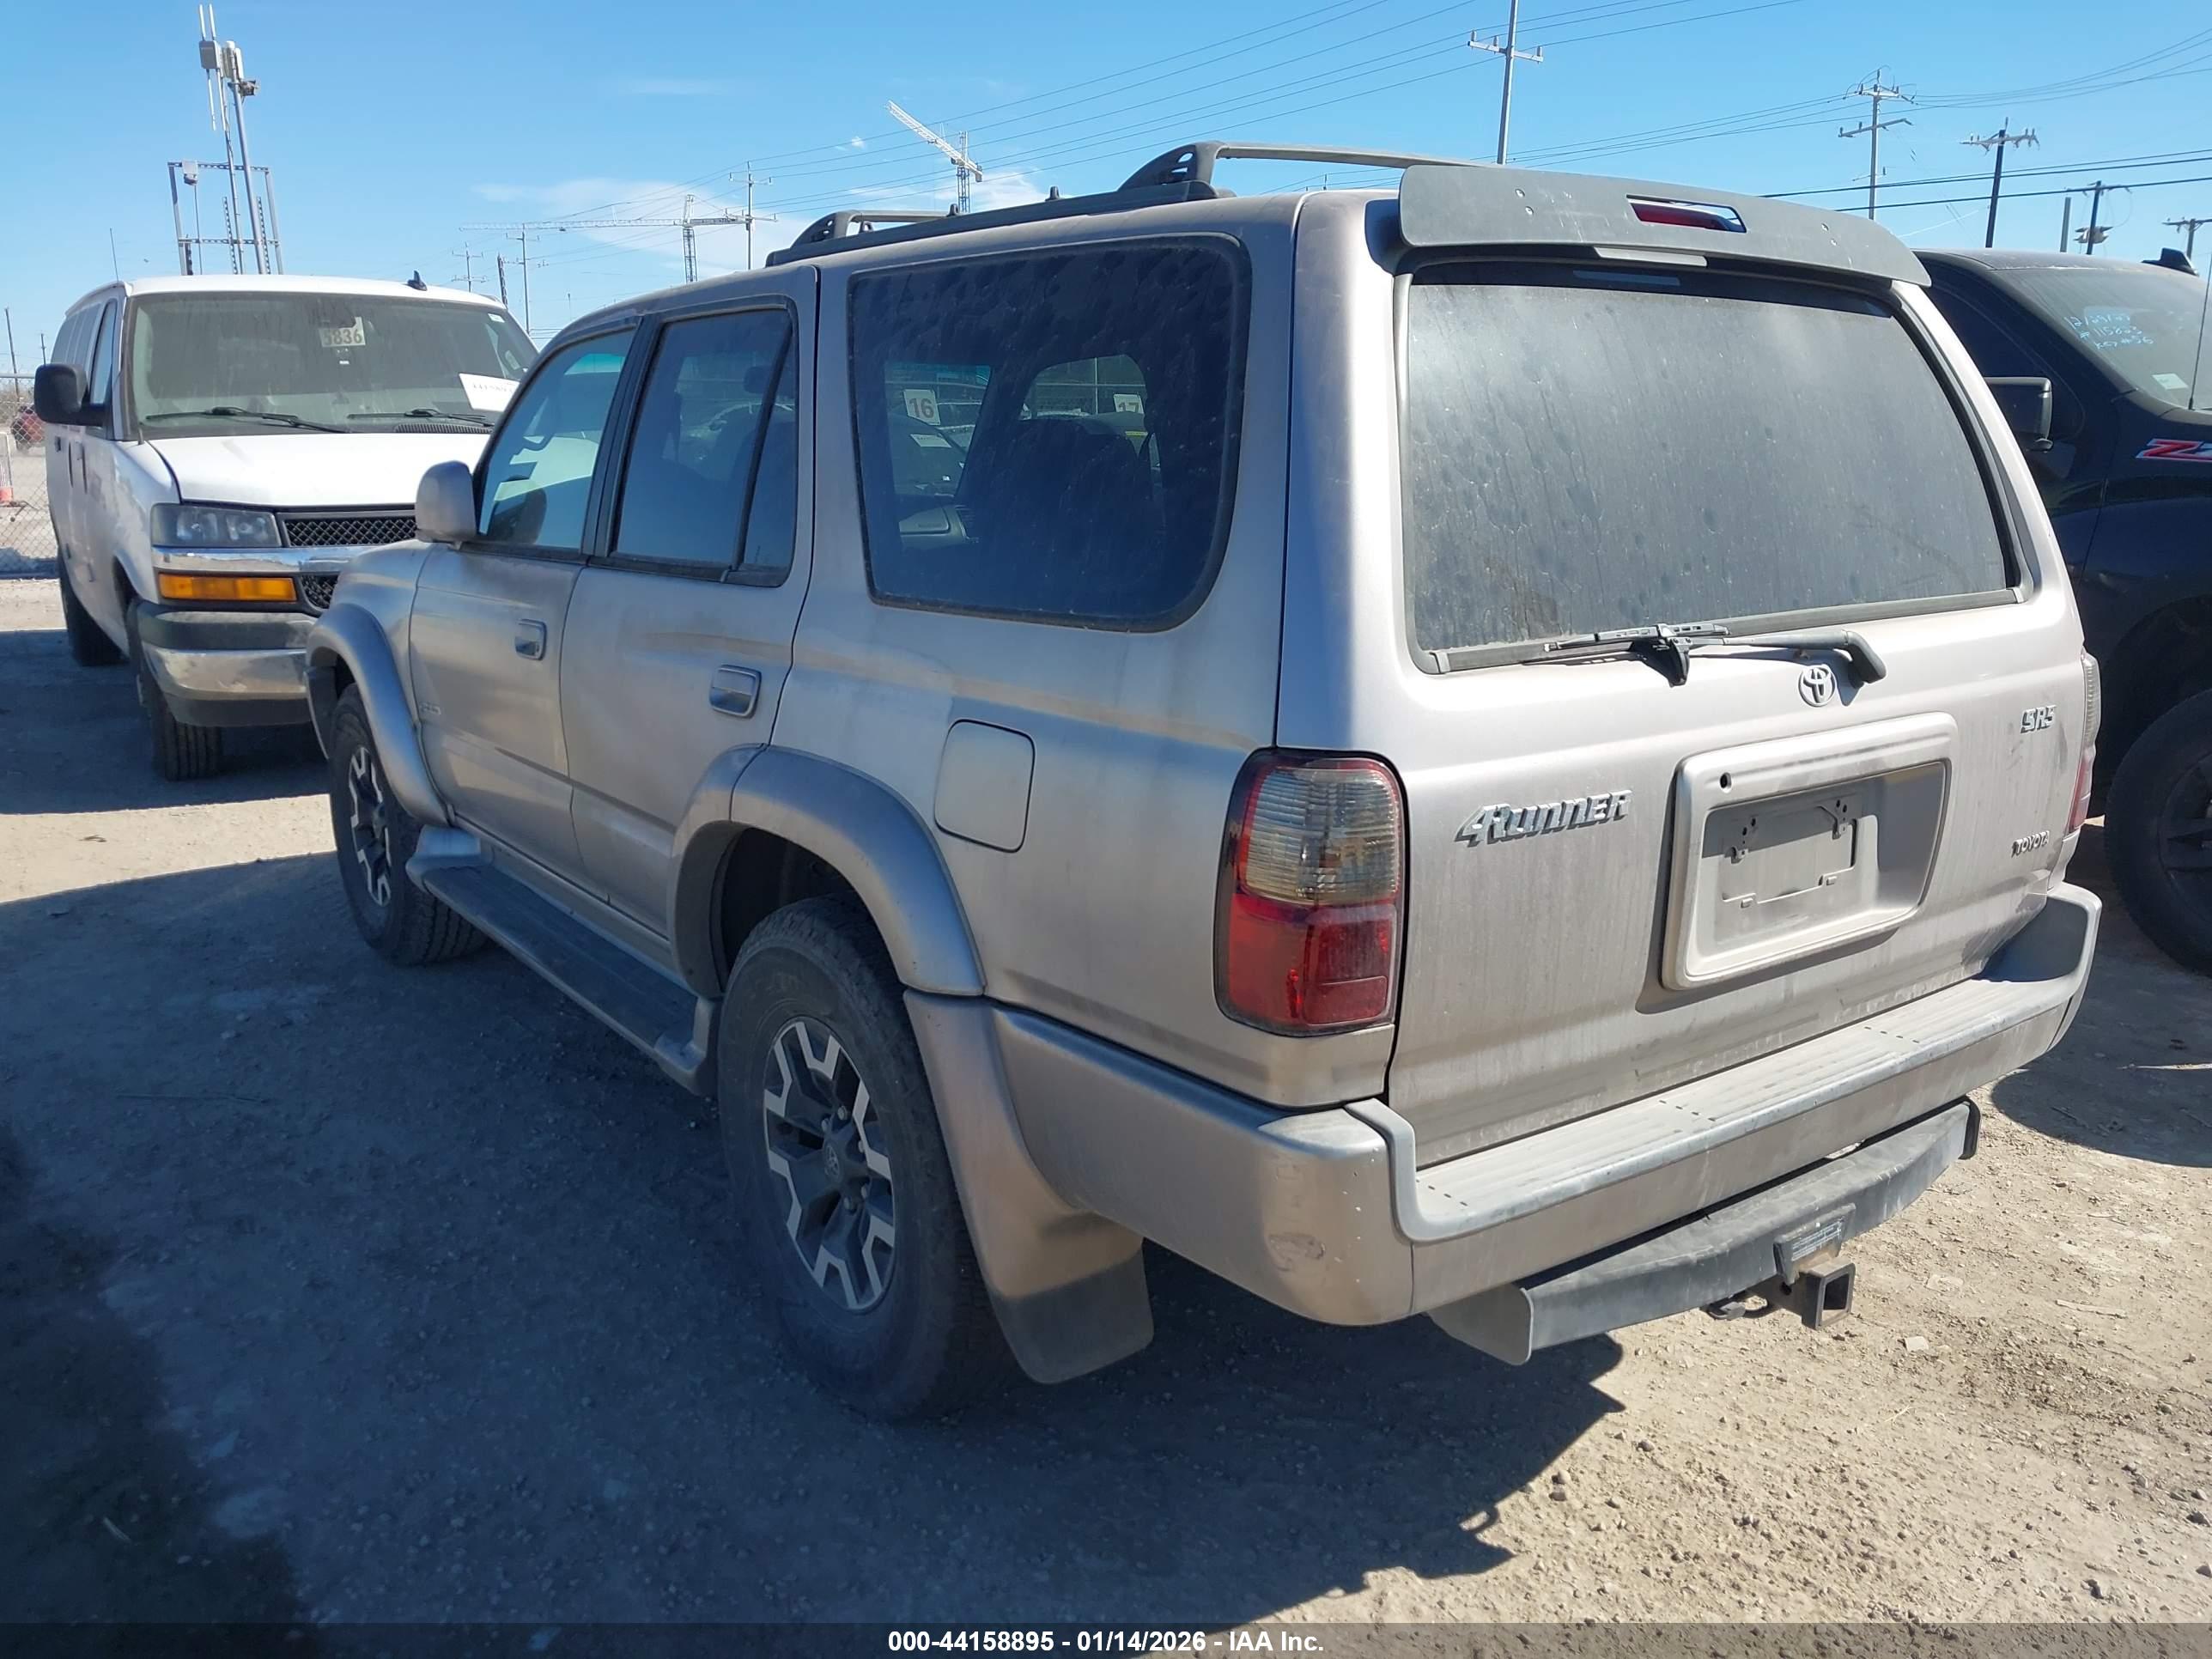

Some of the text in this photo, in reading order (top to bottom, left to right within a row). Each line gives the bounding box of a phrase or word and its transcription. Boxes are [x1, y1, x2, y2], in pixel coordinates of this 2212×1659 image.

[908, 398, 935, 419] 16
[2020, 704, 2057, 734] SR5
[2011, 830, 2051, 858] TOYOTA
